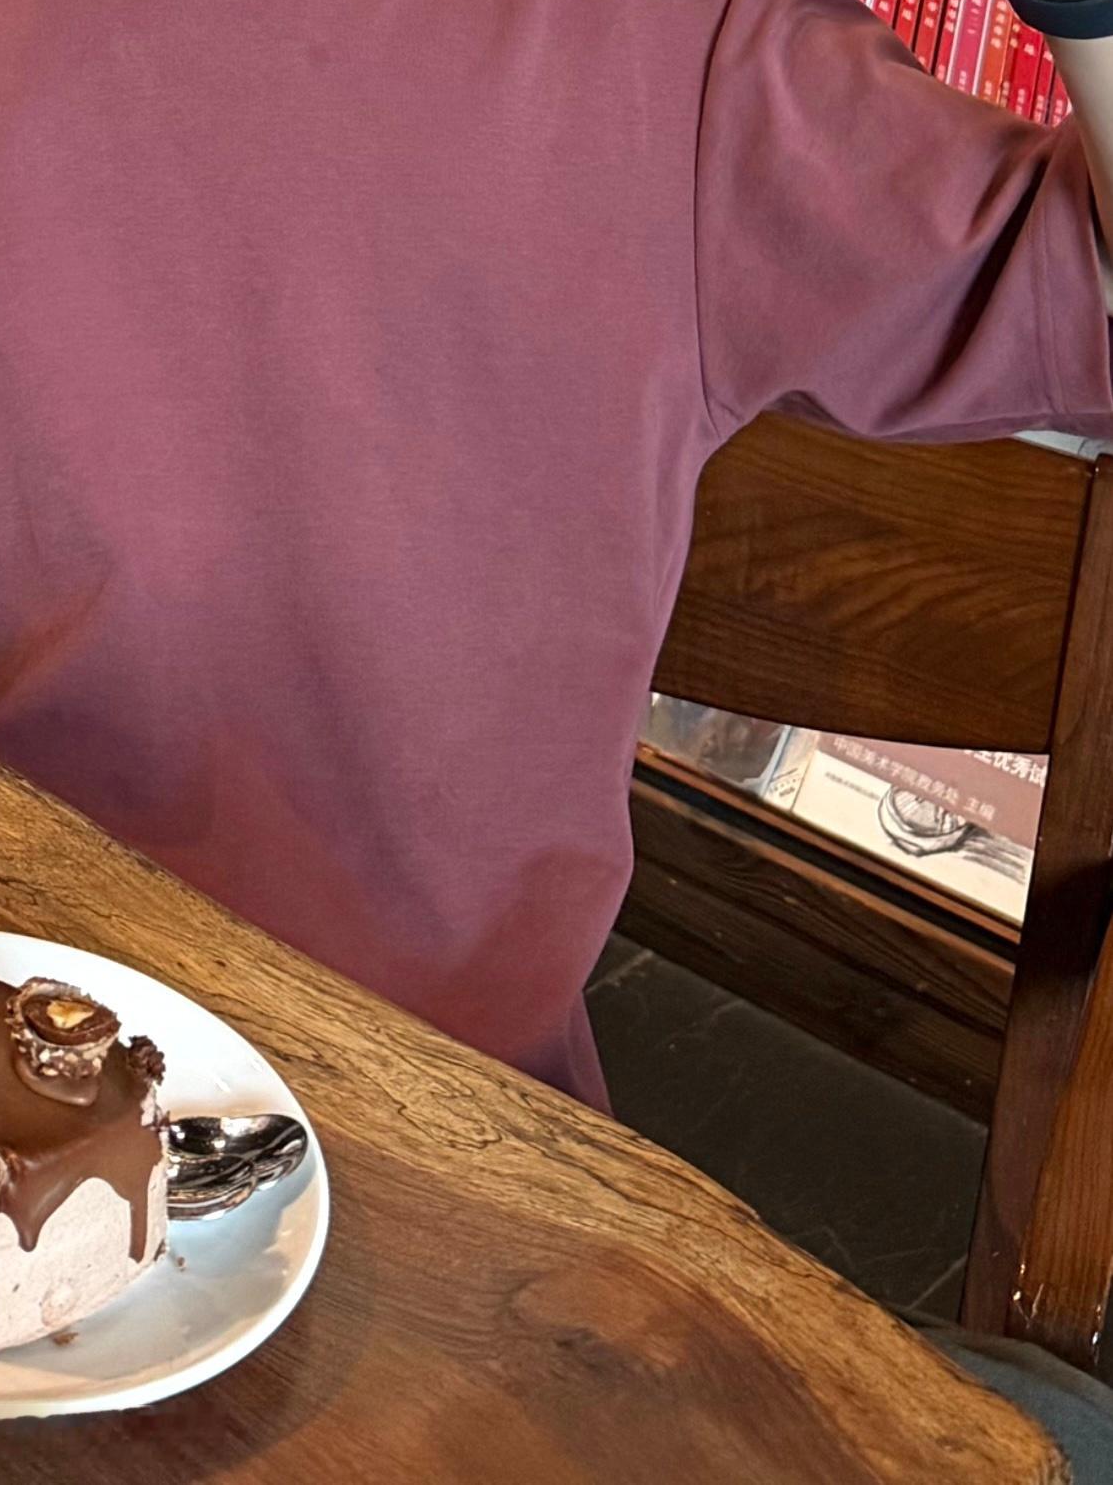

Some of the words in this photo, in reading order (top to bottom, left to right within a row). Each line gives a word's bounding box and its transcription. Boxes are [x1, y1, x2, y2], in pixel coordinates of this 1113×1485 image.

[833, 736, 958, 806] 中国美术学院教务处
